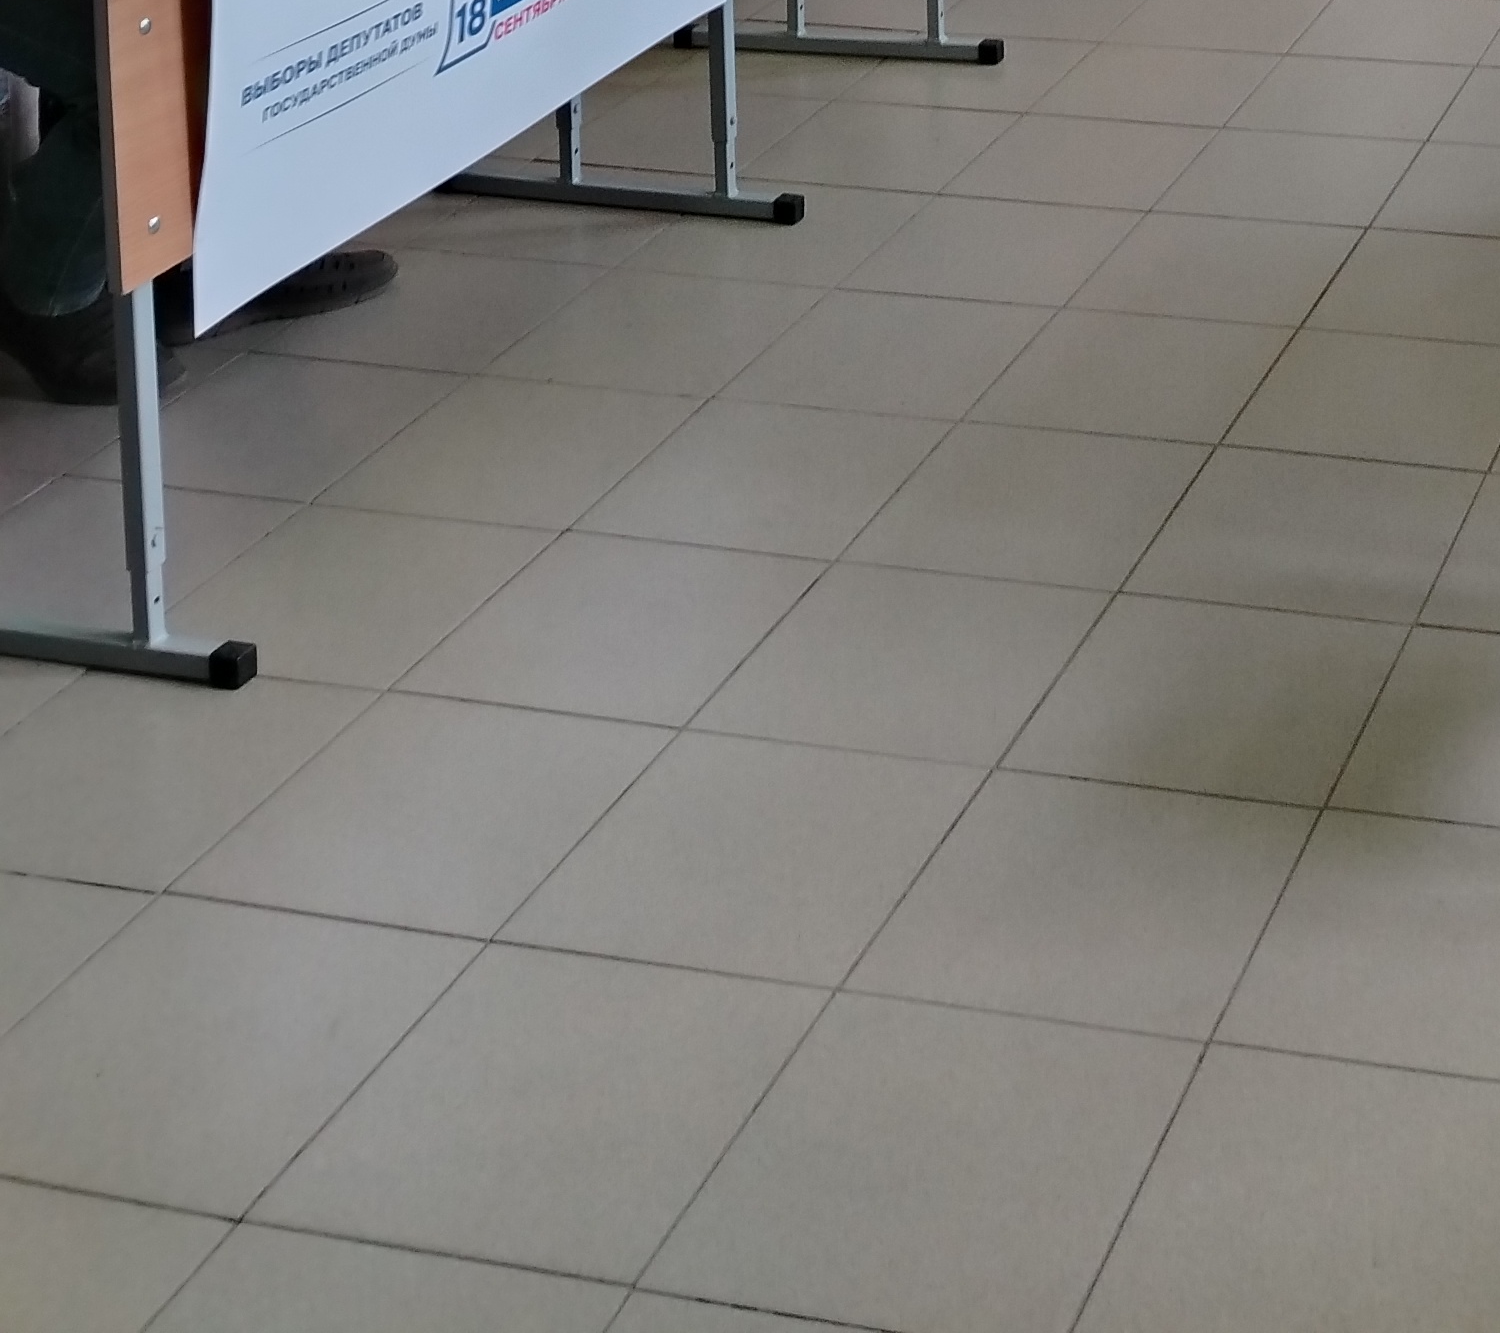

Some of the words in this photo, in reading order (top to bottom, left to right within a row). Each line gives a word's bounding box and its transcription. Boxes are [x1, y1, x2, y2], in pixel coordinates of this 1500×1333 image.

[240, 50, 323, 108] ВЫБОРЫ
[324, 2, 424, 69] ДЕПУТАТОВ
[262, 39, 399, 123] ГОСУДАРСТВЕННОЙ
[400, 21, 440, 55] ДУМЫ
